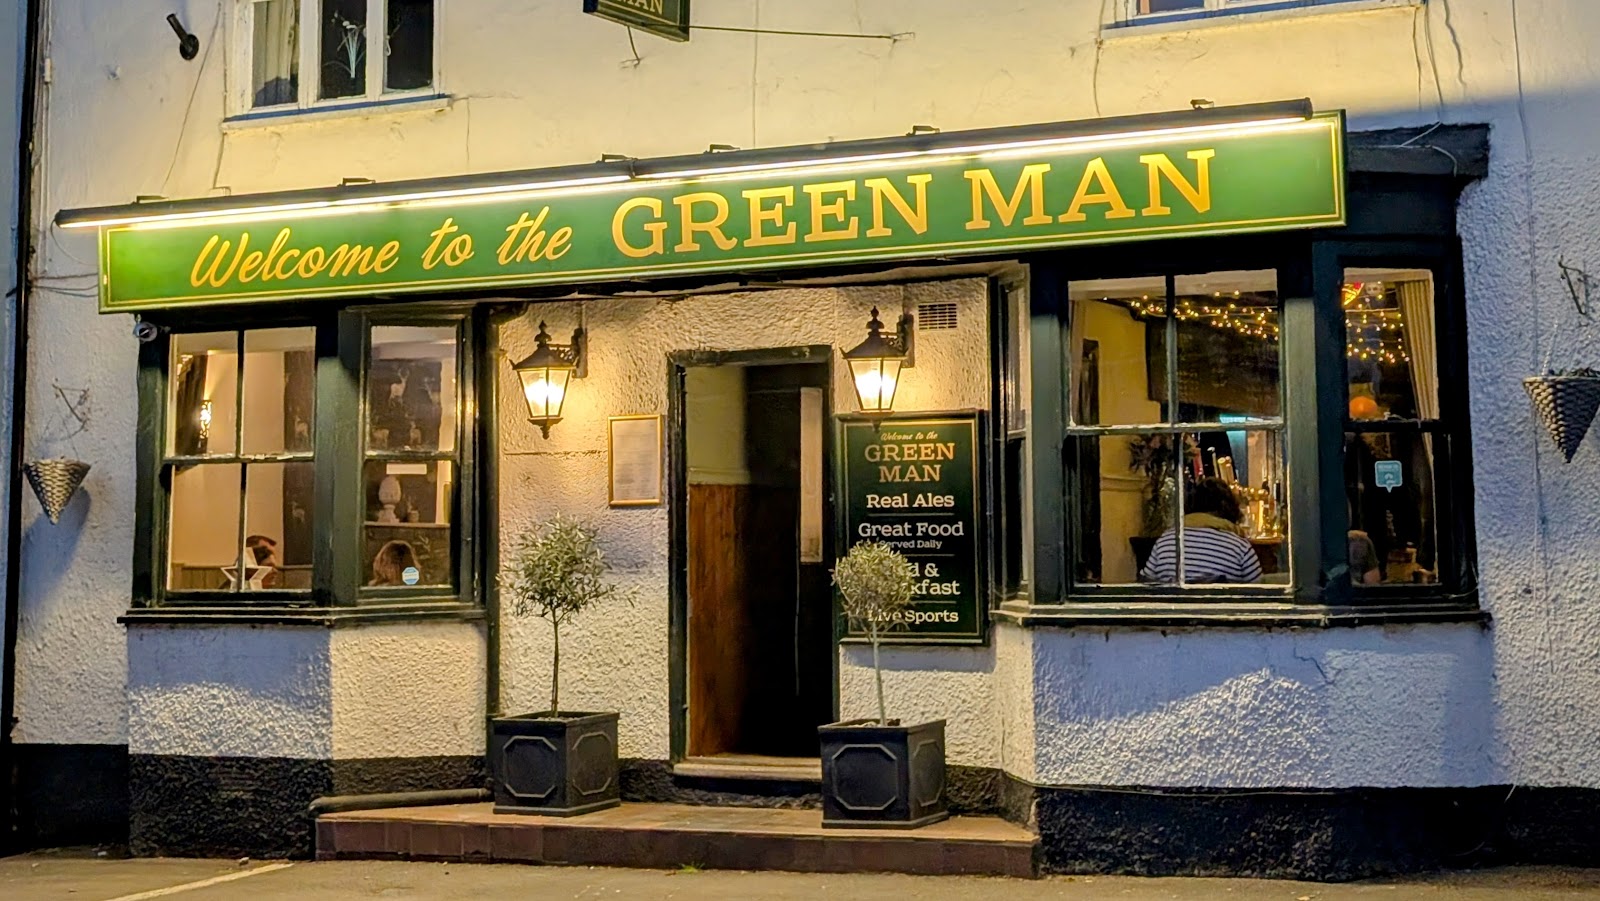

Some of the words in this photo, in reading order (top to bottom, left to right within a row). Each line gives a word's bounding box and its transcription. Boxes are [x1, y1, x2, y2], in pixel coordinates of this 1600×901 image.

[617, 0, 663, 15] AN
[190, 226, 400, 289] Welcome
[421, 217, 475, 271] to
[497, 205, 573, 266] the
[611, 173, 932, 258] GREEN
[964, 149, 1215, 230] MAN
[880, 432, 913, 441] Welcome
[915, 431, 924, 440] to
[926, 430, 938, 440] the
[864, 442, 955, 462] GREEN
[878, 464, 942, 483] MAN
[866, 493, 909, 509] Real
[912, 492, 955, 508] Ales
[858, 522, 913, 537] Great
[916, 521, 964, 536] Food
[916, 539, 943, 549] Daily
[924, 562, 940, 577] &
[867, 608, 902, 622] Live
[904, 609, 959, 624] Sports
